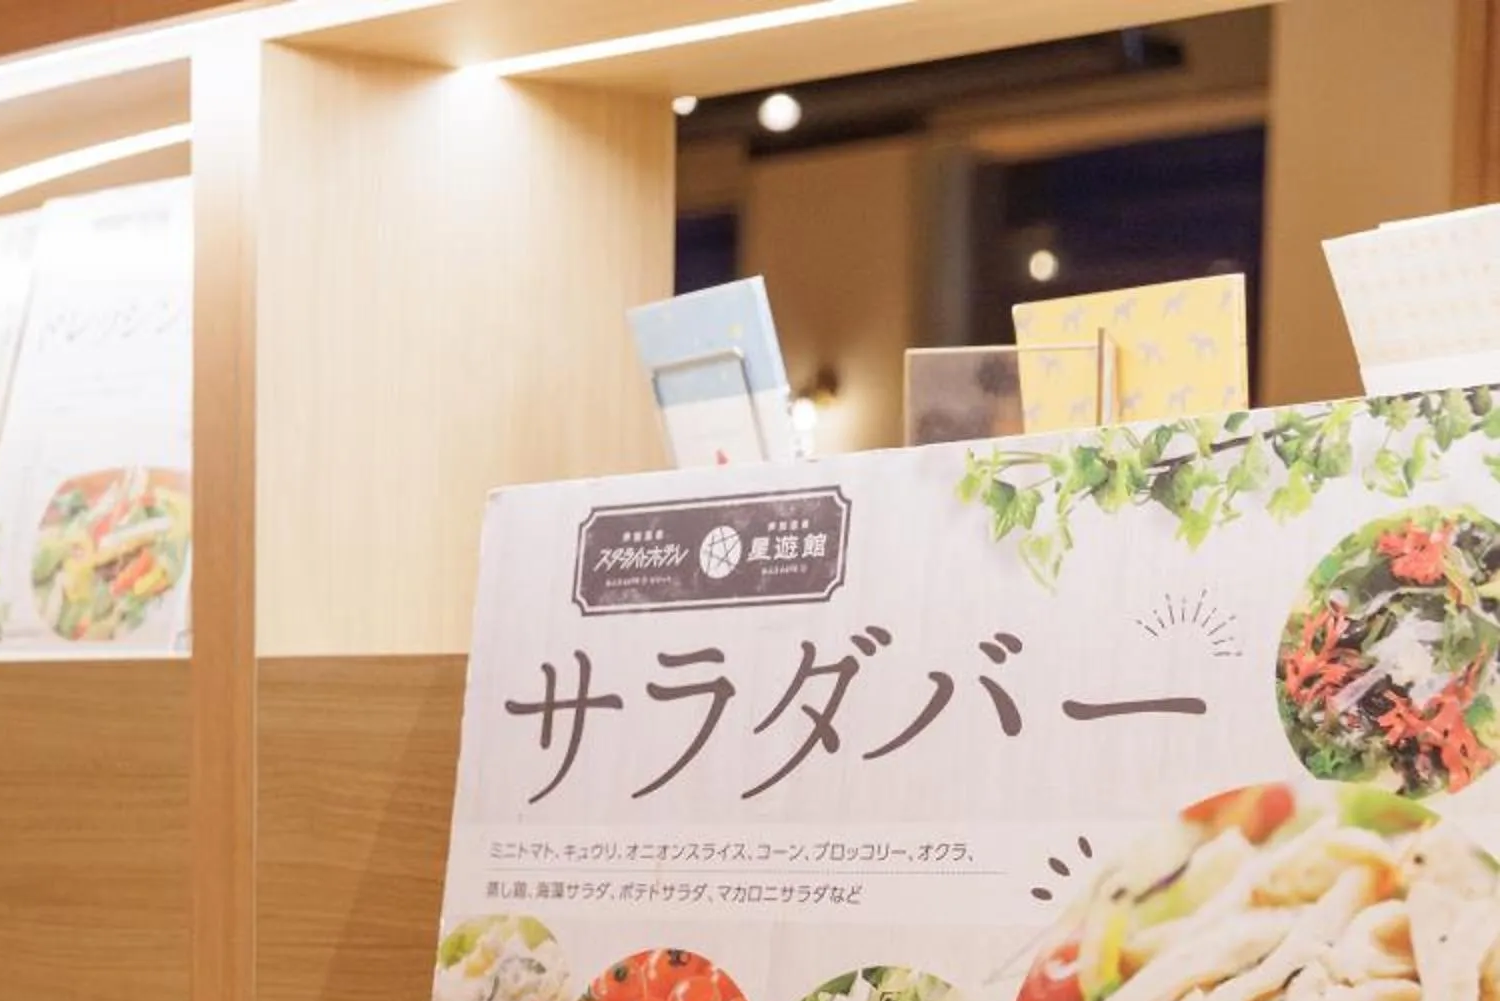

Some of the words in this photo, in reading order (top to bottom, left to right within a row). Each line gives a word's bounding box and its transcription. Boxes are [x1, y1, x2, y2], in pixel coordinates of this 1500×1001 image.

[746, 532, 828, 562] 星遊館
[504, 625, 1207, 804] サラダバー
